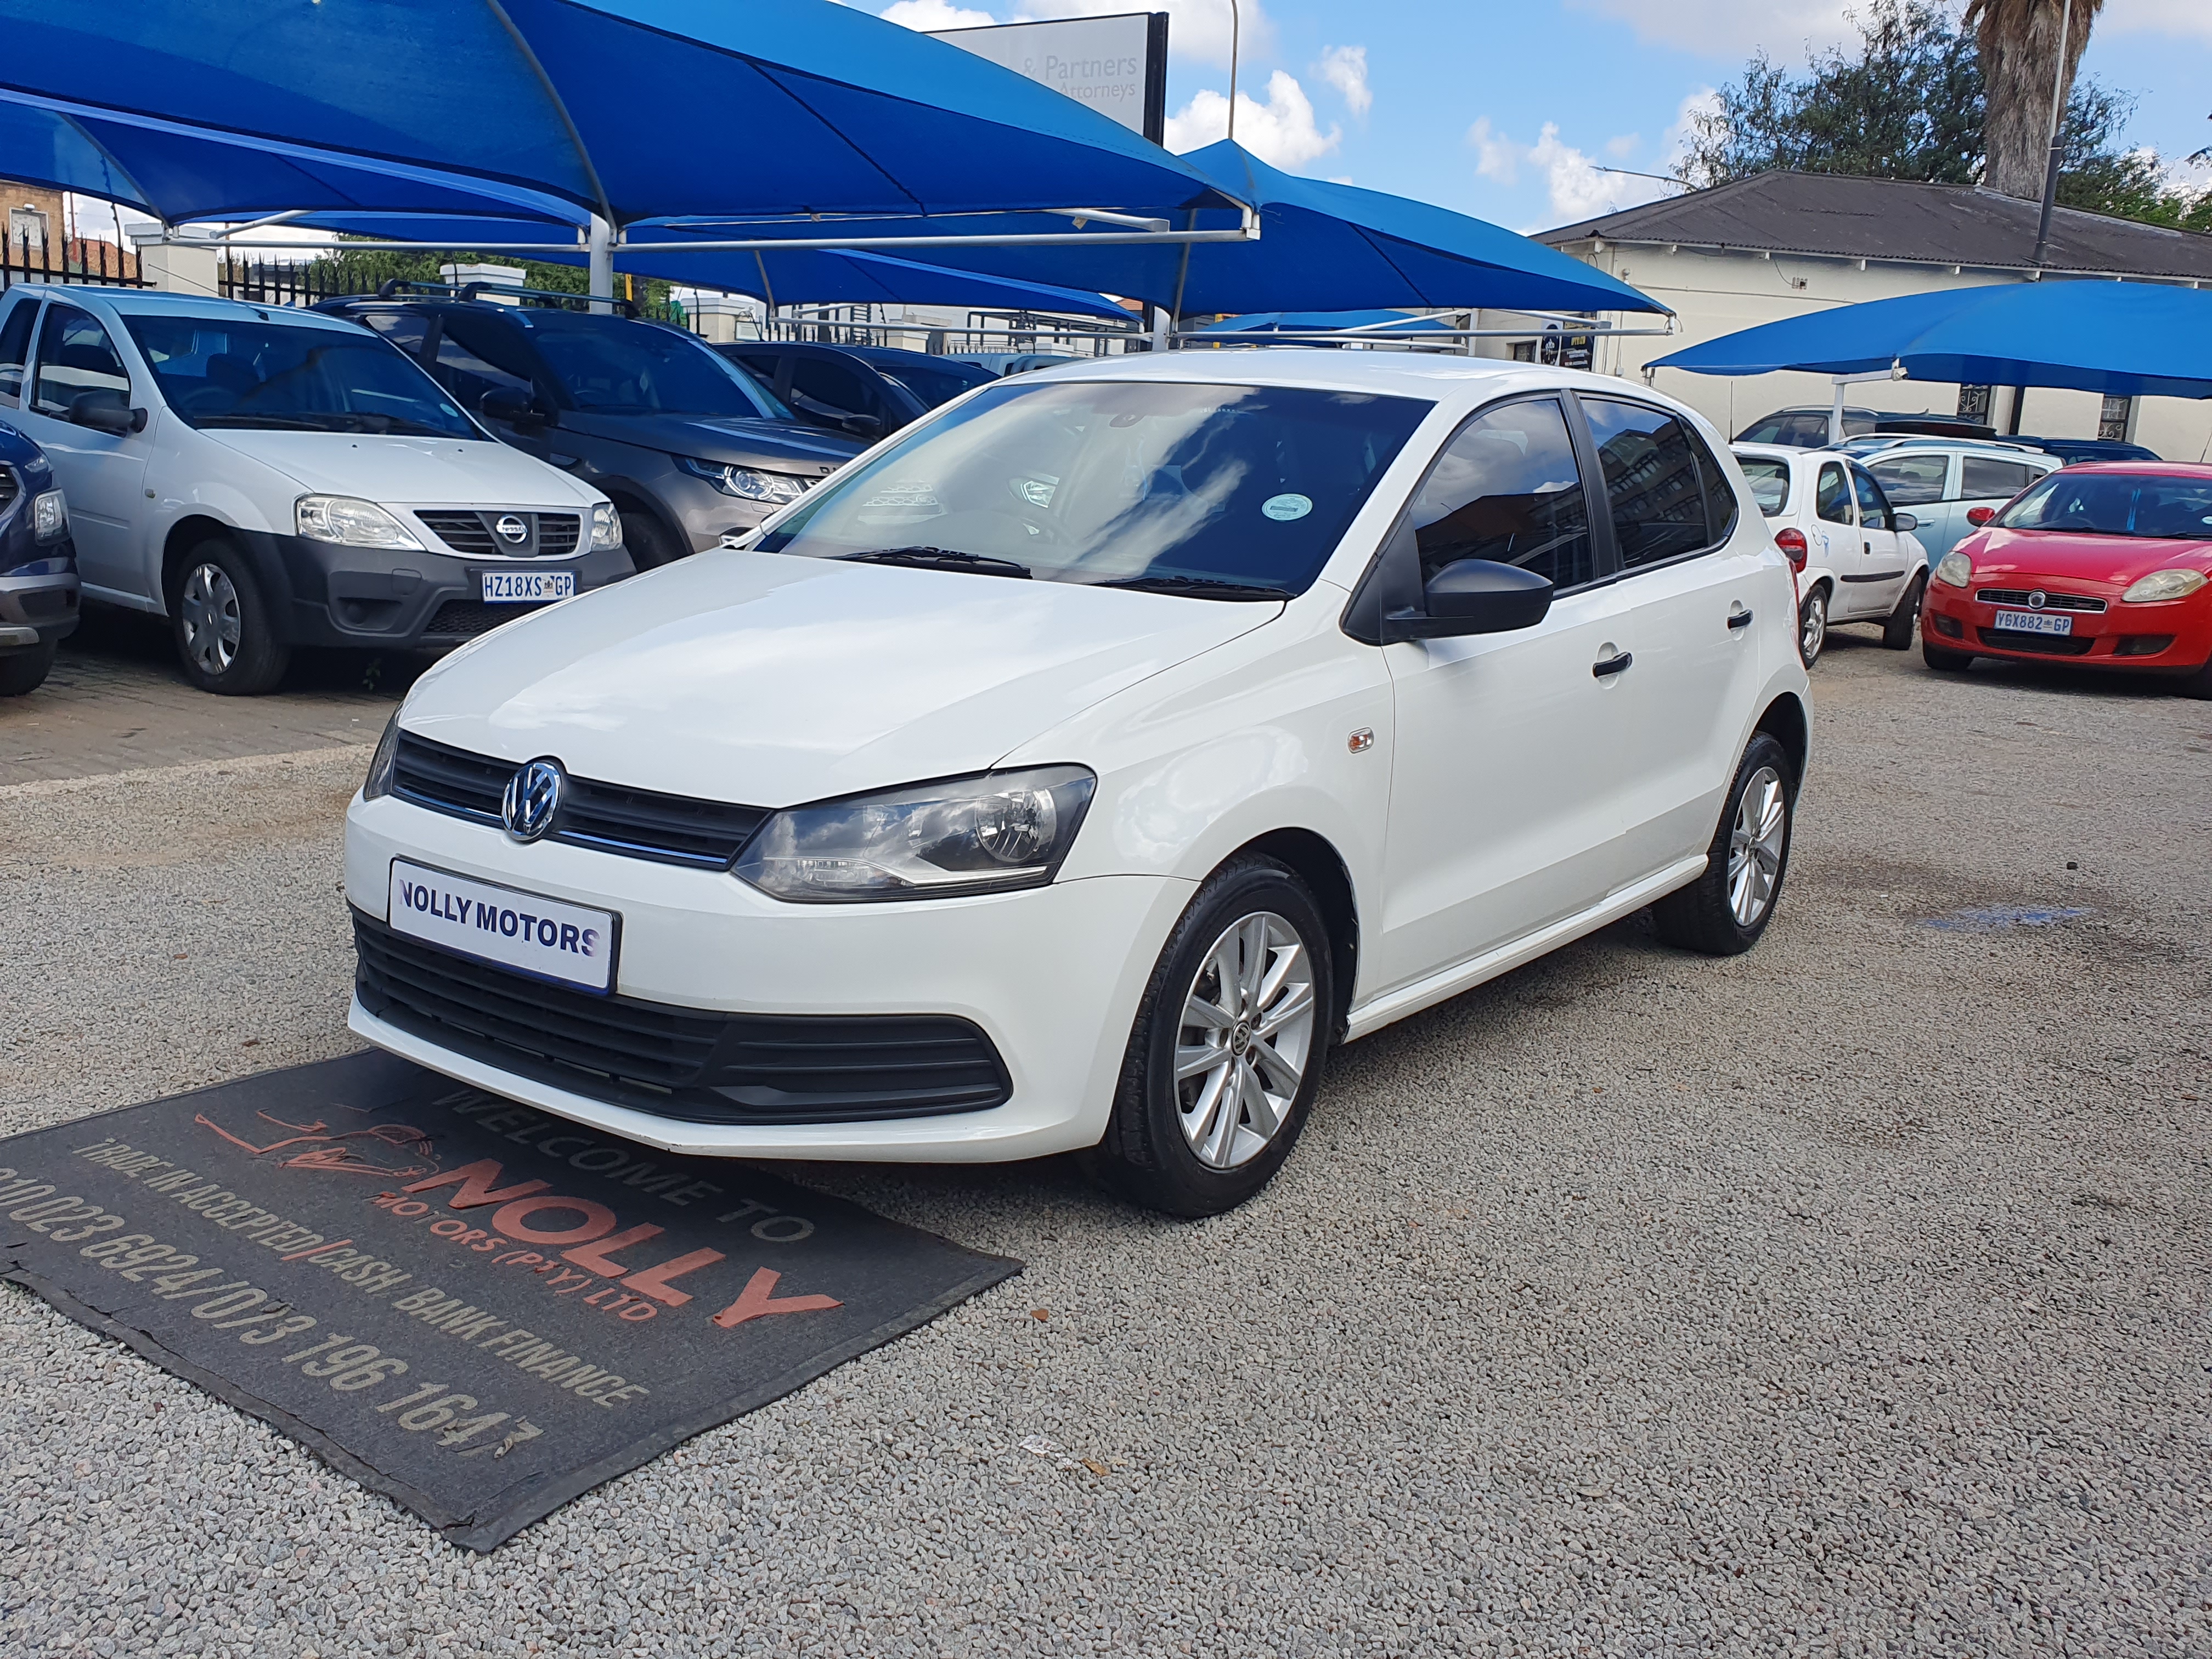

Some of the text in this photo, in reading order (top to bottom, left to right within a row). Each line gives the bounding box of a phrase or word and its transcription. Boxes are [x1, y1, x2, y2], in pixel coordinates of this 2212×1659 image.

[1046, 55, 1137, 81] Partners
[1060, 82, 1136, 103] Attorneys
[484, 576, 571, 597] HZ18XS GP
[1997, 613, 2069, 632] YGX882 GP
[399, 879, 600, 957] NOLLY MOTORS
[432, 1090, 814, 1242] WELCOME TO
[71, 1137, 175, 1179] TRADE
[142, 1169, 203, 1192] IN
[391, 1286, 509, 1341] BANK
[477, 1329, 650, 1408] FINANCE
[401, 1158, 843, 1328] NOLLY
[492, 1250, 593, 1296] (PTY)
[583, 1287, 658, 1321] LTD
[9, 1196, 126, 1242] 023
[79, 1234, 317, 1345] 6924/073
[281, 1332, 408, 1391] 196
[375, 1381, 545, 1459] 1647
